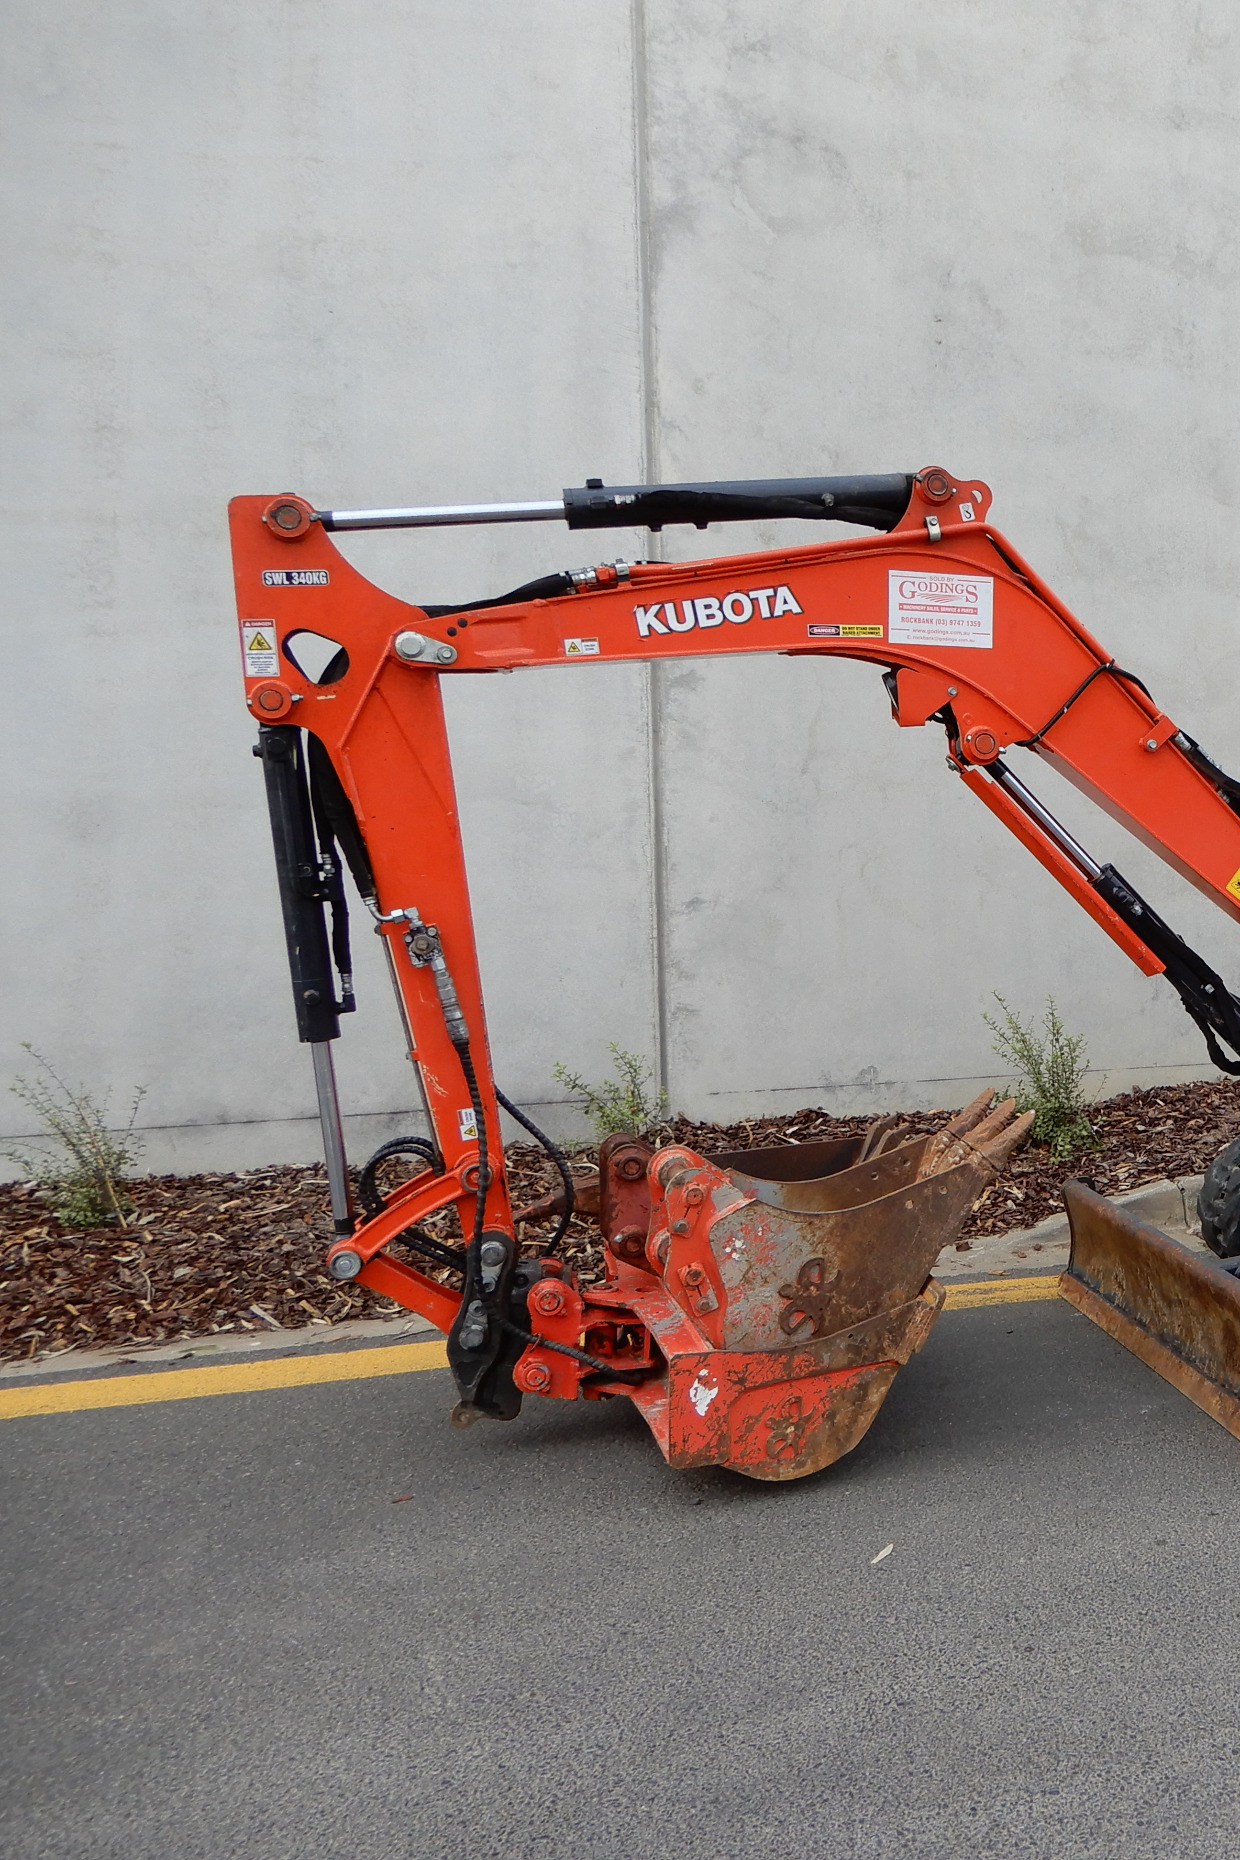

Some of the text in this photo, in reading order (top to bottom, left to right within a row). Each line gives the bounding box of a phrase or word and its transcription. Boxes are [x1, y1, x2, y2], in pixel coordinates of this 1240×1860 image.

[265, 571, 327, 585] SWL 340KG
[636, 586, 801, 636] KUBOTA
[901, 616, 934, 624] ROCKBANK
